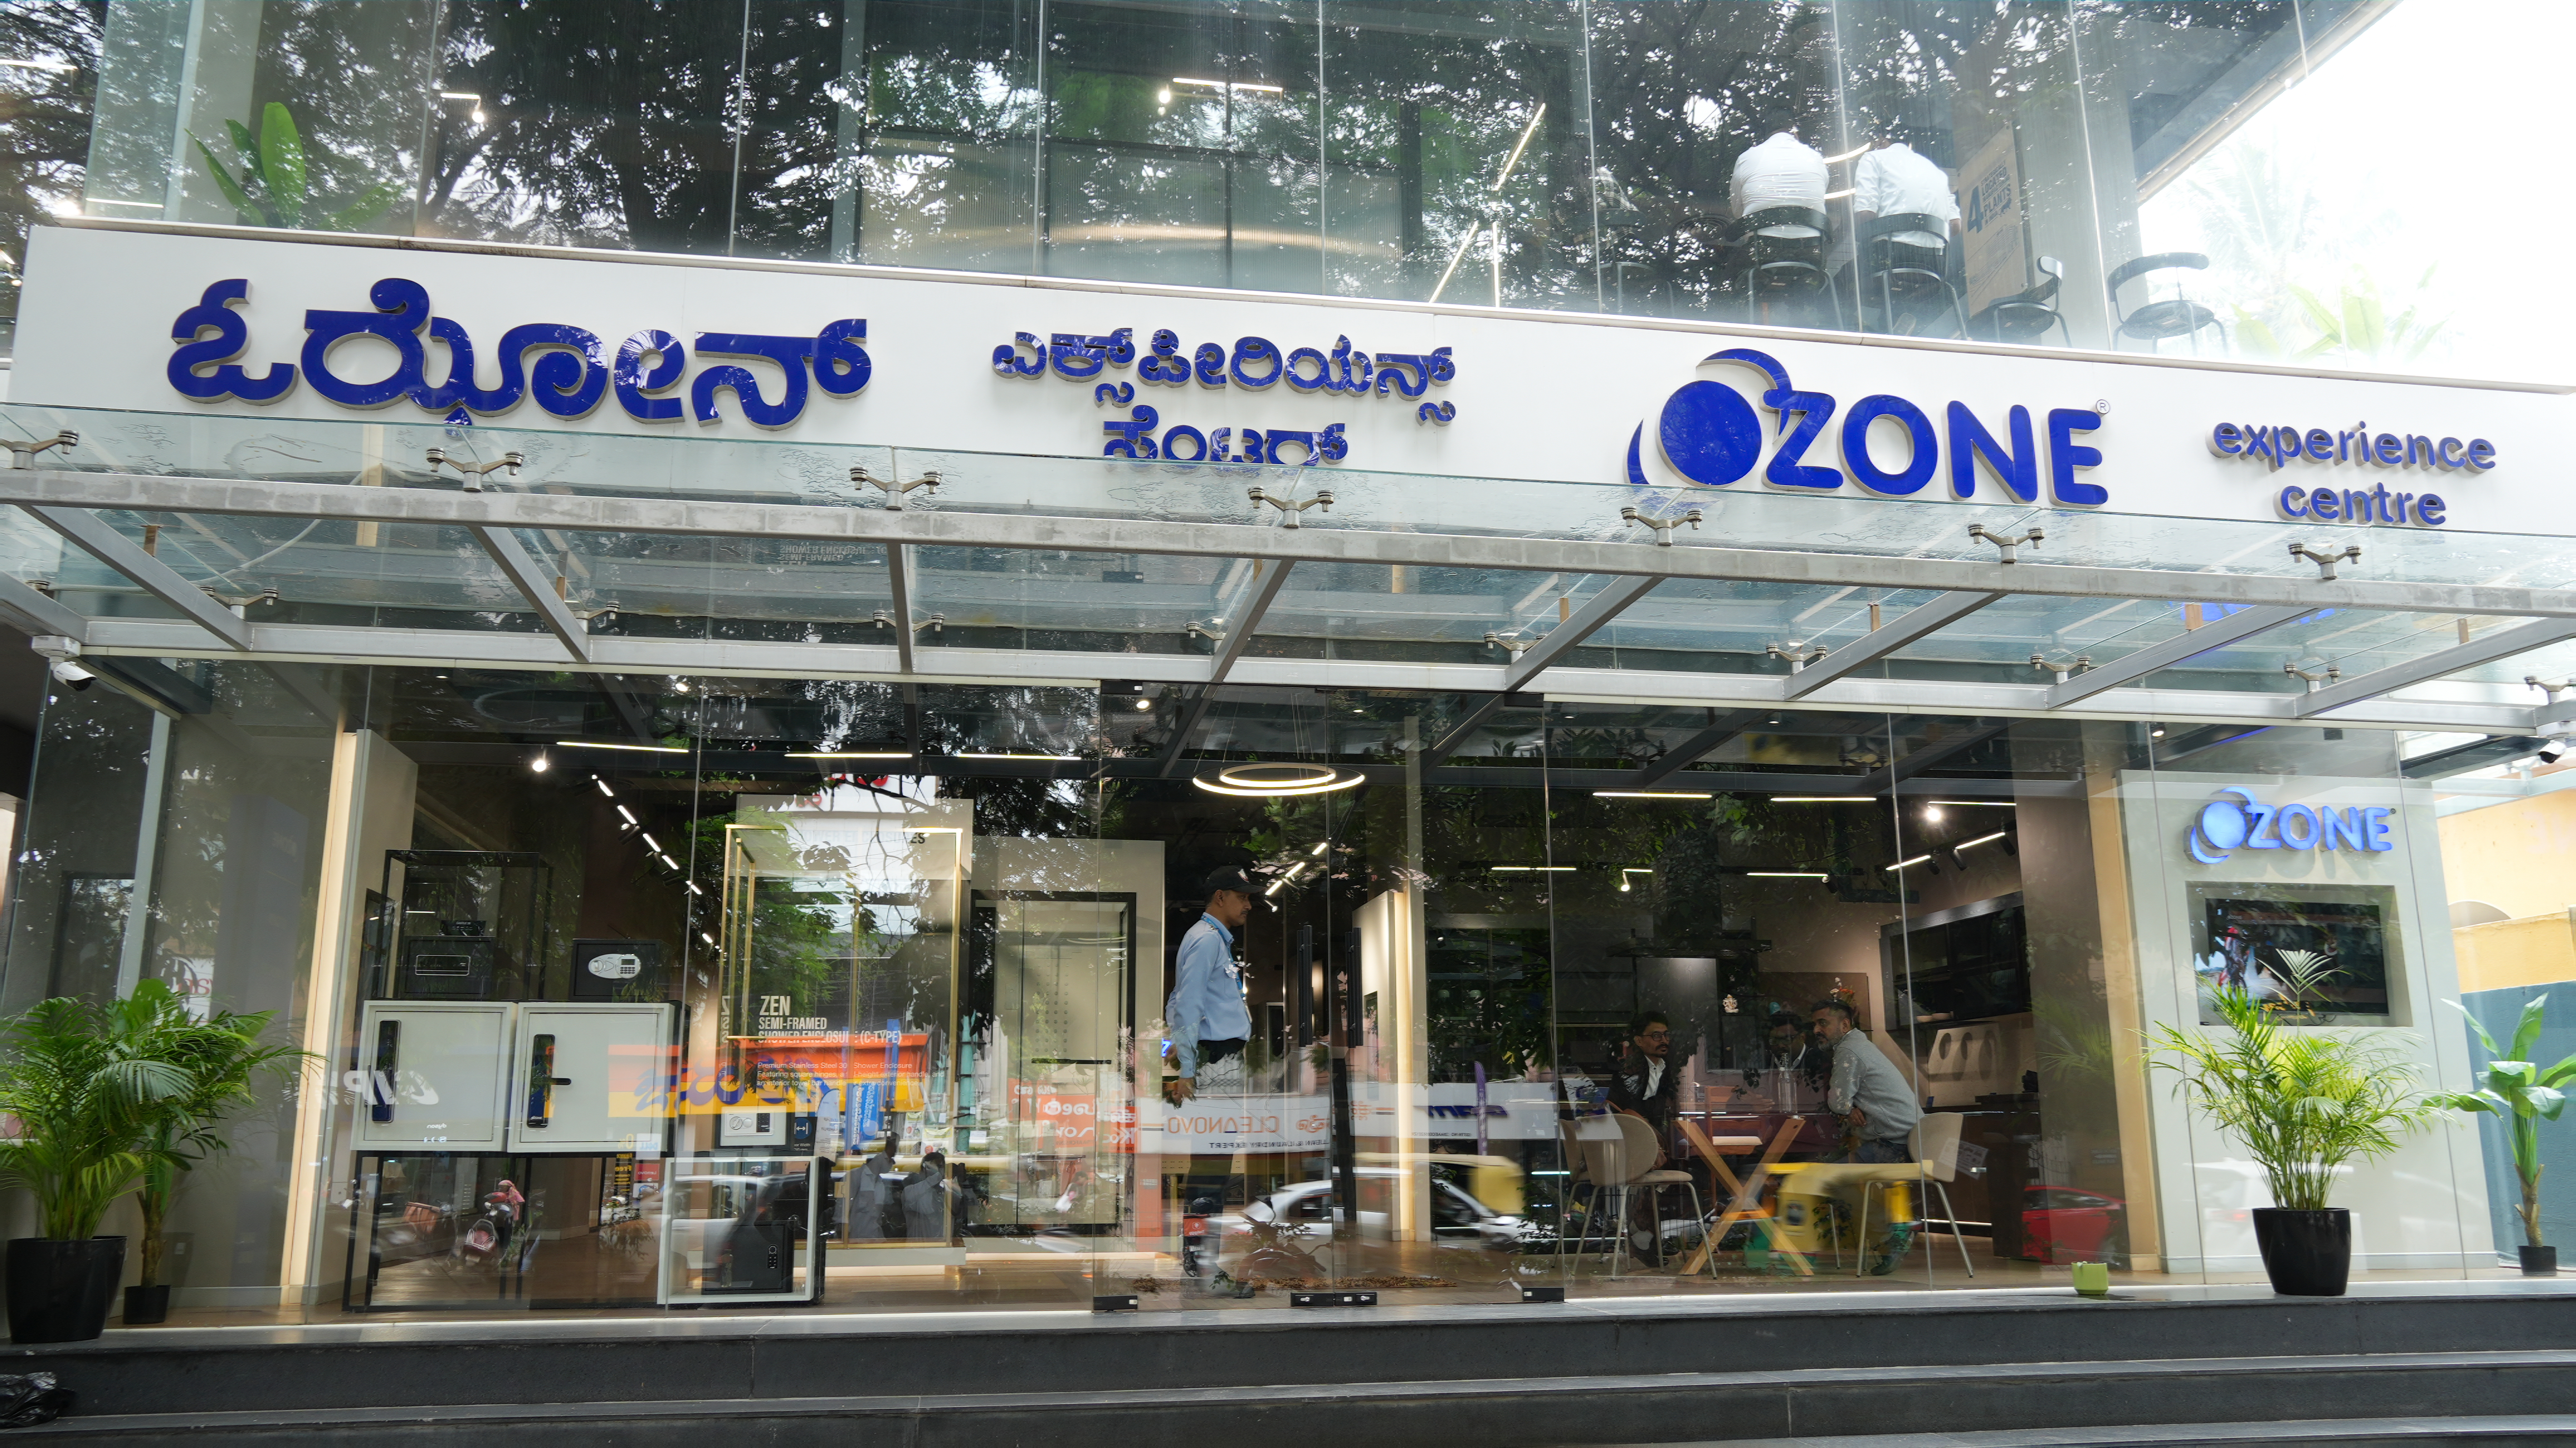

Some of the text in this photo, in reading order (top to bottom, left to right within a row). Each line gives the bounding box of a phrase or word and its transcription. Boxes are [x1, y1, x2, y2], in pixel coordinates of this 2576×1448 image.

[1982, 166, 2007, 196] LOCATED
[1967, 184, 1984, 234] 4
[1983, 183, 2011, 217] PLANTS
[2205, 420, 2497, 474] experience
[2274, 481, 2447, 527] centre
[759, 995, 791, 1016] ZEN
[758, 1017, 827, 1029] SEMI-FRAMED
[758, 1030, 800, 1043] SHOWER
[860, 1030, 902, 1045] (C-TYPE)
[757, 1071, 788, 1079] Featuring
